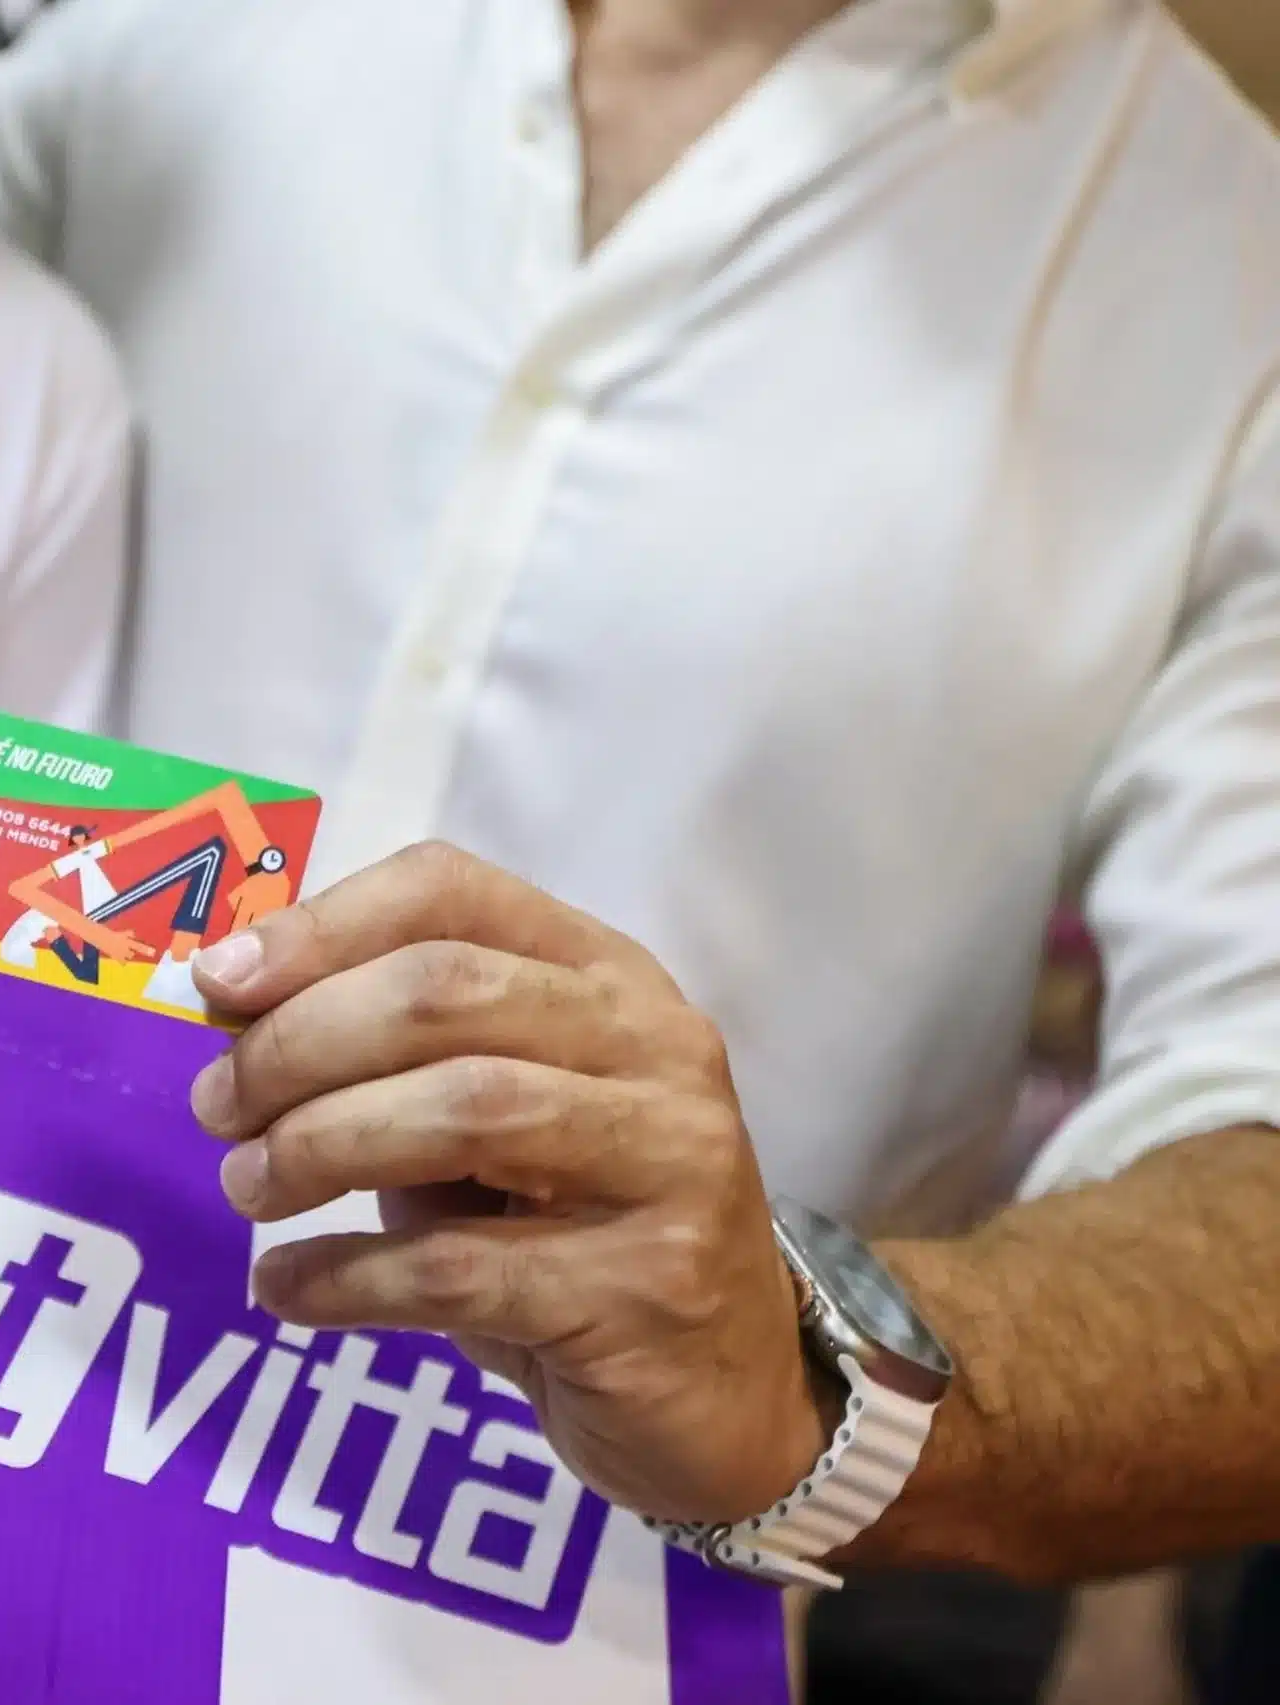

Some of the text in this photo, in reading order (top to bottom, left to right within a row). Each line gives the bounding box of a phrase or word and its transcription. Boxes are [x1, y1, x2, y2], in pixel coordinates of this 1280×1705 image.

[4, 744, 41, 771] NO
[34, 751, 114, 791] FUTURO
[6, 829, 60, 852] MENDE
